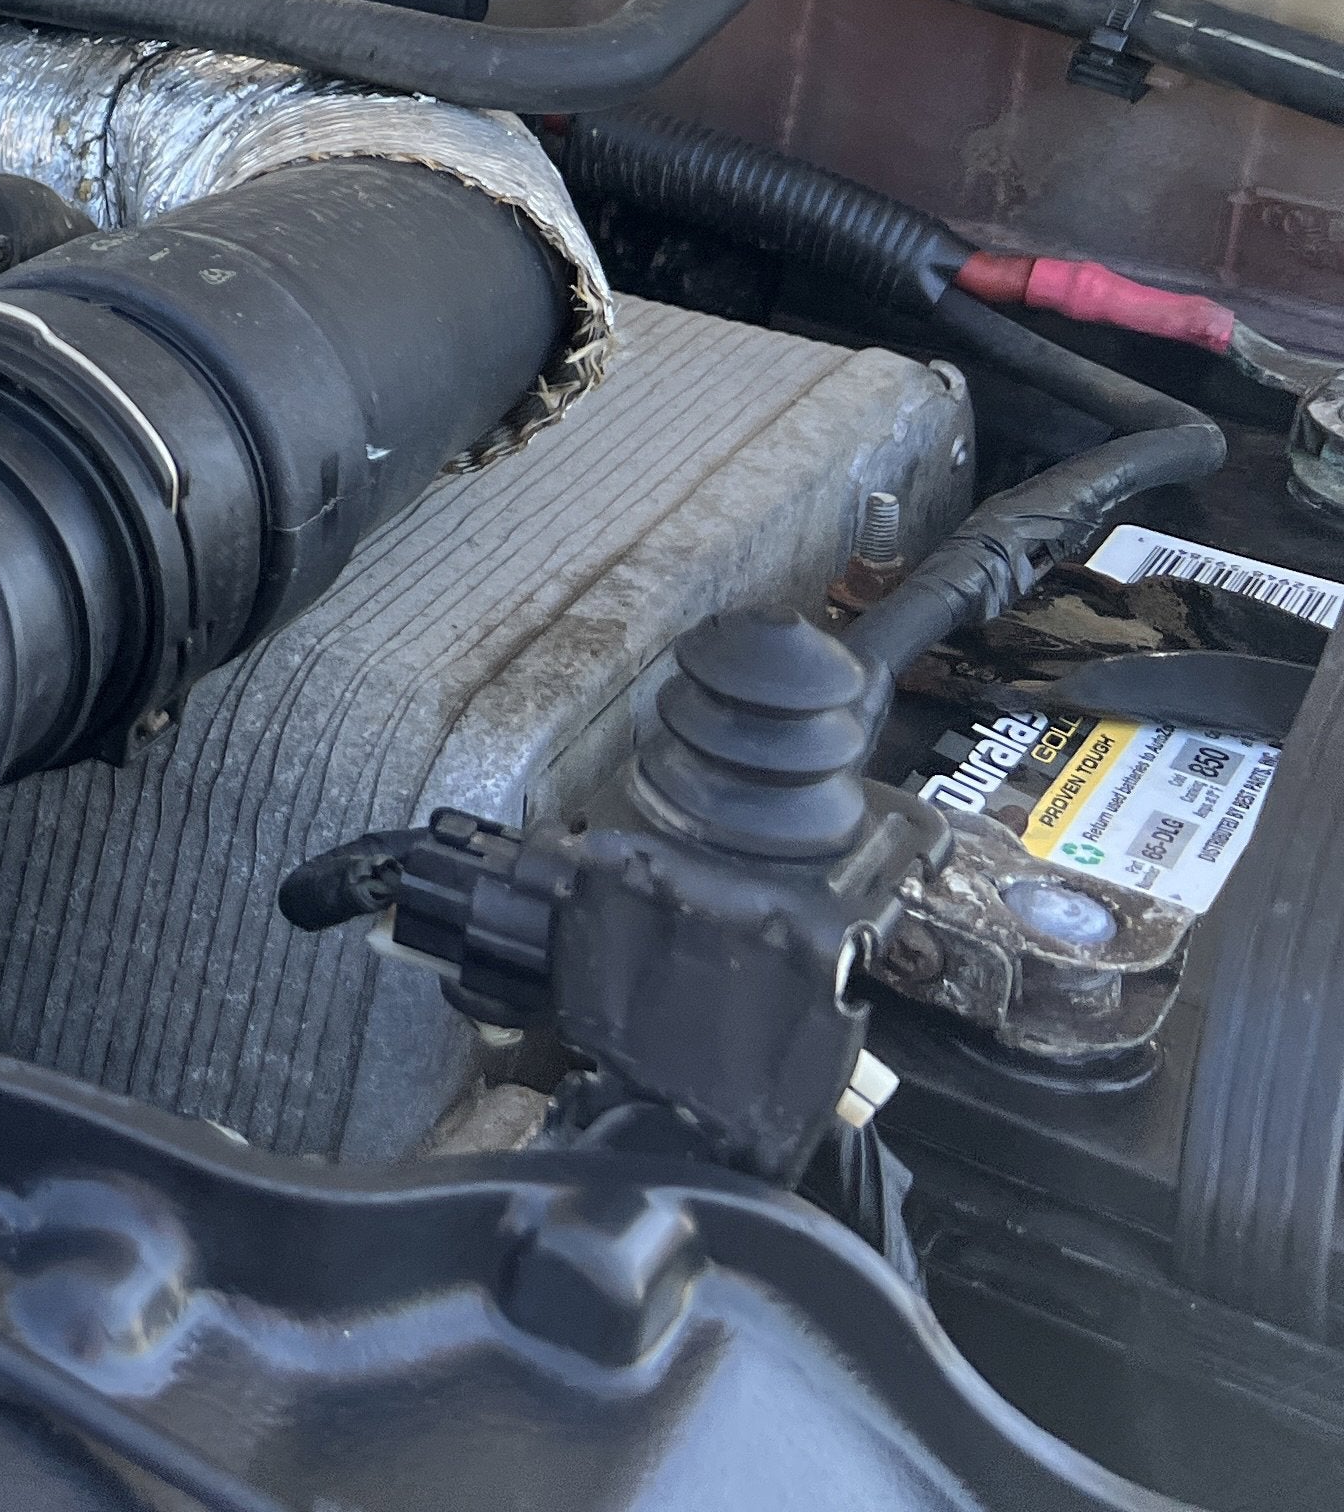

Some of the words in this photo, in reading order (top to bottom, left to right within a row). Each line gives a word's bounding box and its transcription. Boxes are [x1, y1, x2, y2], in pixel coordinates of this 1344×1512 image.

[1039, 774, 1086, 828] PROVEN
[1075, 734, 1115, 775] TOUGH
[1188, 747, 1230, 779] 850
[1082, 811, 1113, 842] Return
[1107, 792, 1127, 813] used
[1139, 752, 1156, 763] to
[1141, 818, 1184, 861] 65-DLG
